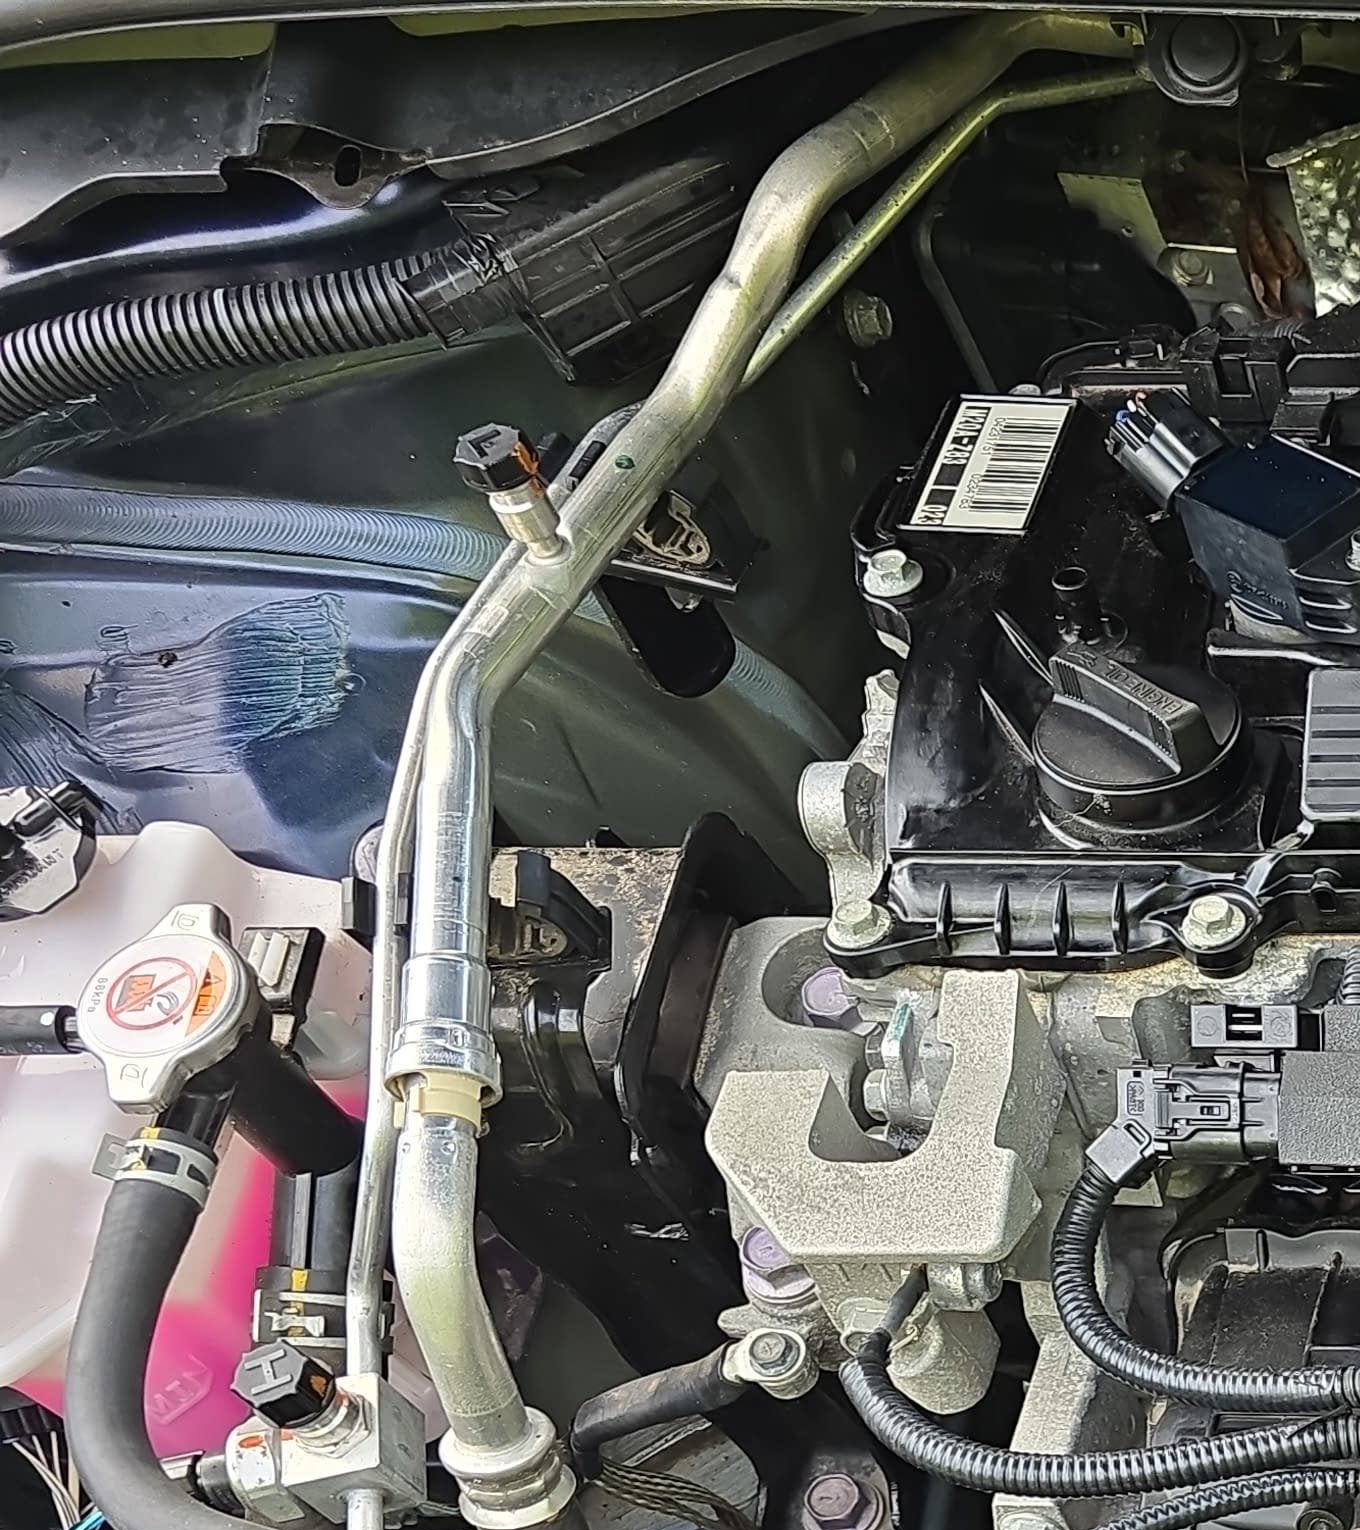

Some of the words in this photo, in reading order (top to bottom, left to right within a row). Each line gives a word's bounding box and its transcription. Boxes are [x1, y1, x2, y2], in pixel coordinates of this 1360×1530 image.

[1103, 663, 1128, 685] OIL
[1125, 676, 1183, 713] ENGINE
[244, 1349, 293, 1397] H
